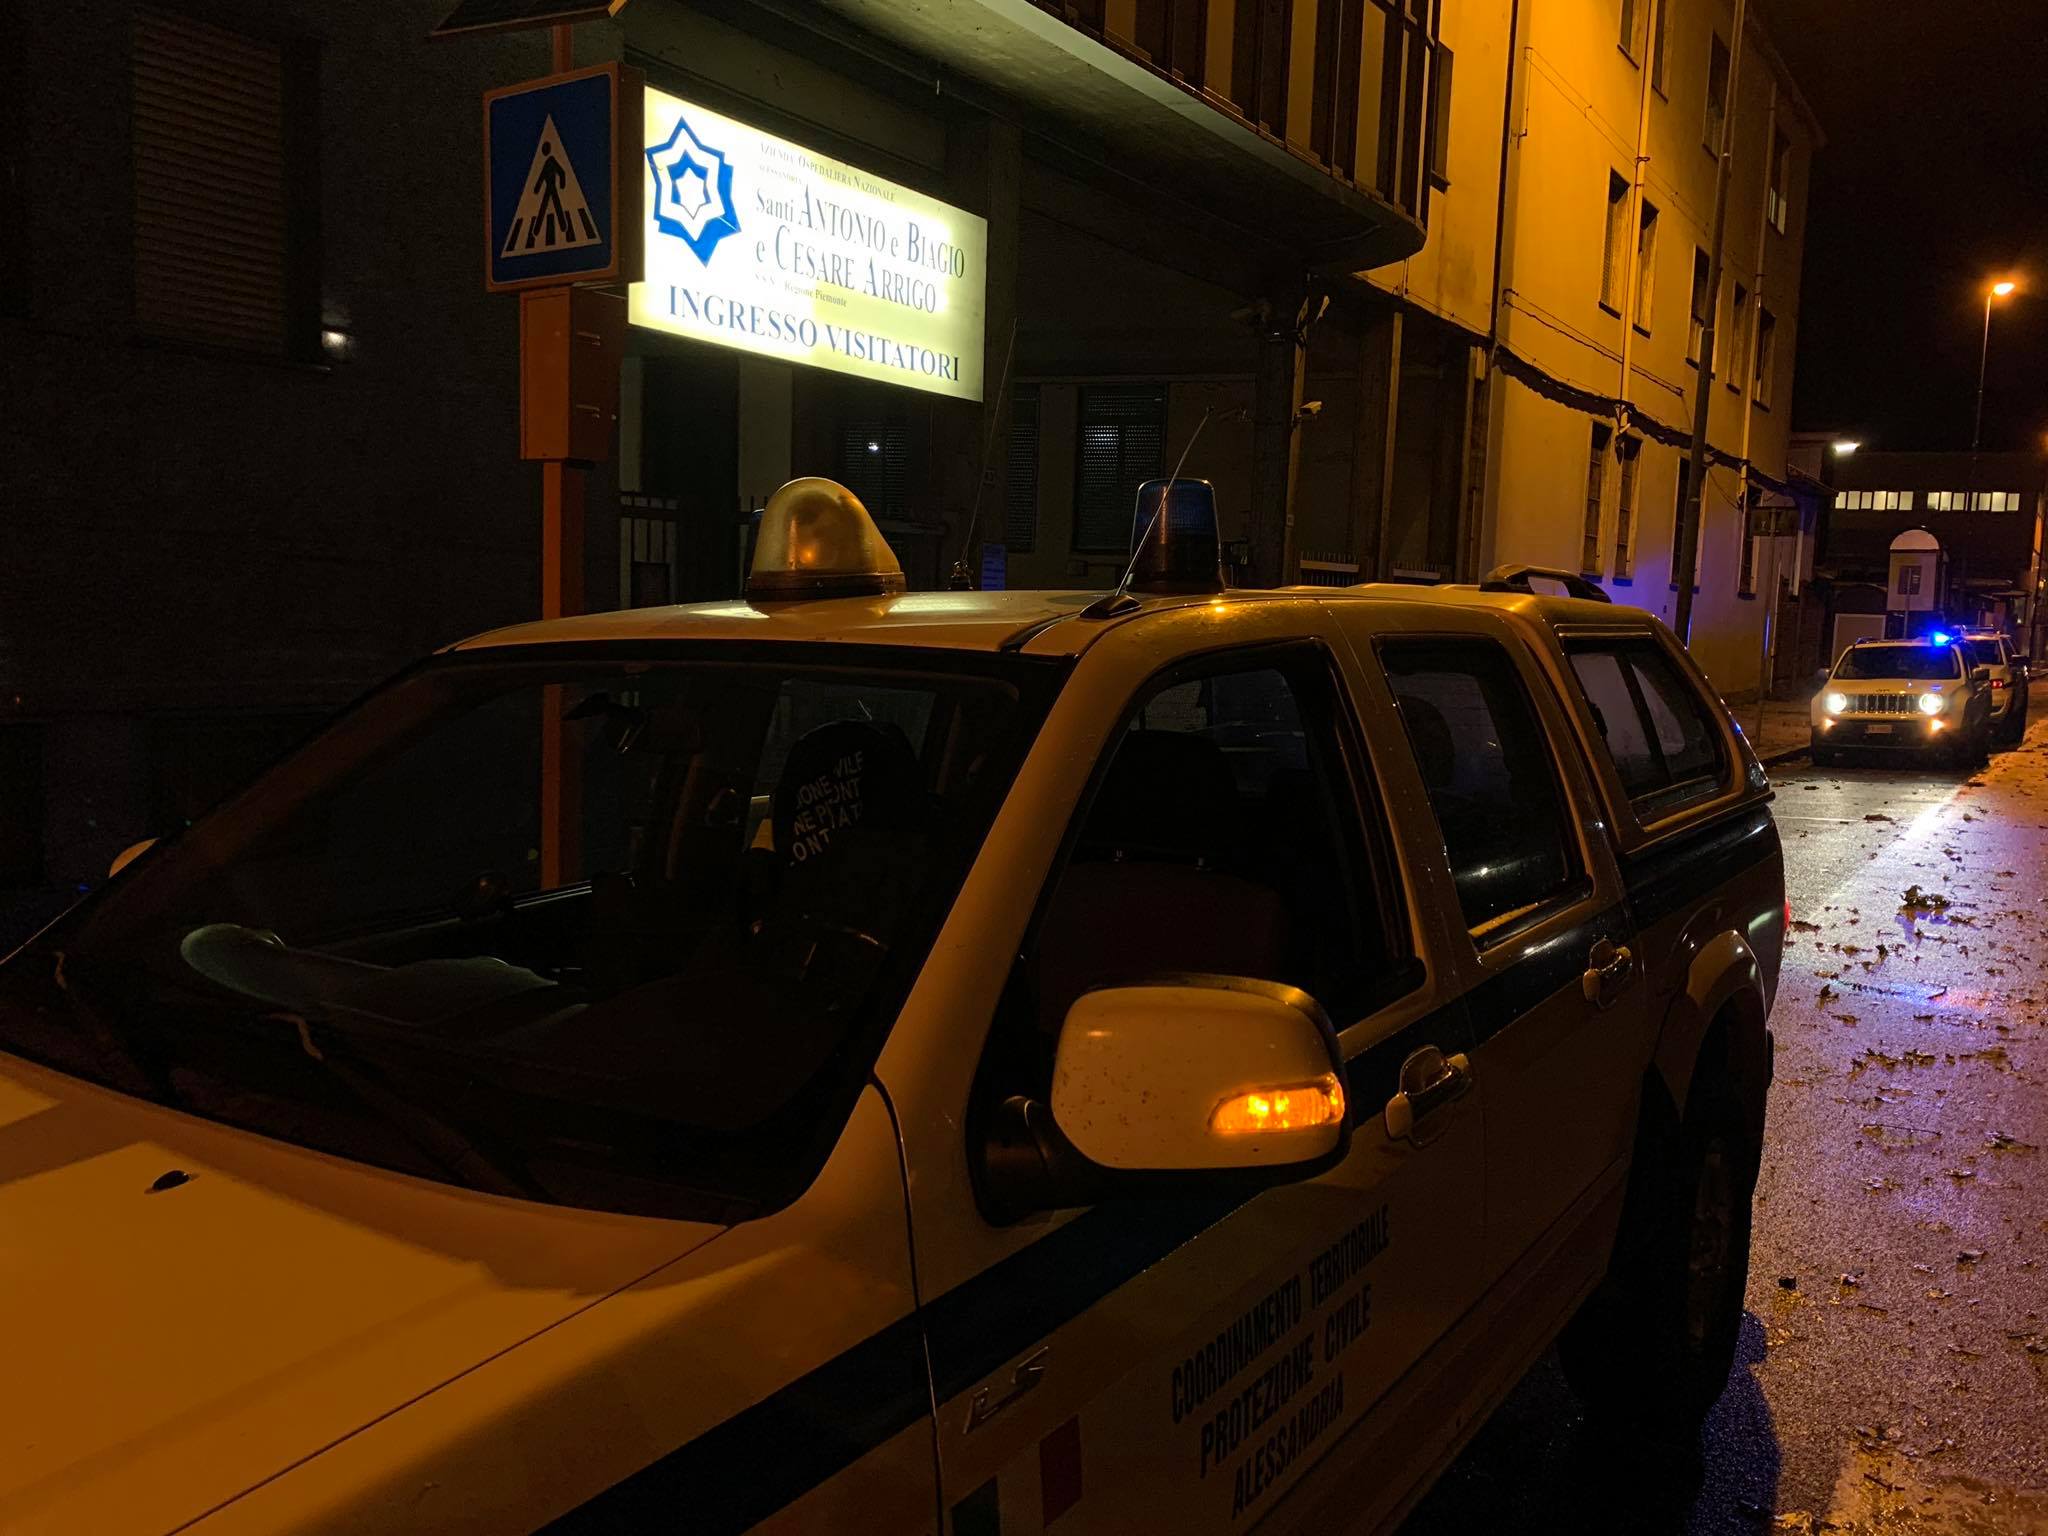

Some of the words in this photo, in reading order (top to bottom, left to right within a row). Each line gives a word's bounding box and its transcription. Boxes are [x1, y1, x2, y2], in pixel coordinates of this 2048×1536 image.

[798, 155, 851, 187] OSPEDALIERA
[854, 176, 896, 202] NAZIONALE
[756, 187, 794, 223] Santi
[799, 184, 886, 257] ANTONIO
[891, 237, 899, 256] e
[907, 222, 965, 279] BIAGIO
[756, 240, 766, 264] e
[775, 225, 855, 291] CESARE
[863, 255, 936, 314] ARRIGO
[669, 286, 818, 348] INGRESSO
[825, 324, 959, 383] VISITATORI
[815, 289, 848, 307] Piemonte
[1171, 1274, 1302, 1424] COORDINAMENTO
[1308, 1203, 1390, 1307] TERRITORIALE
[1200, 1333, 1314, 1479] PROTEZIONE
[1324, 1283, 1372, 1364] CIVILE
[1232, 1372, 1344, 1520] ALESSANDRIA
